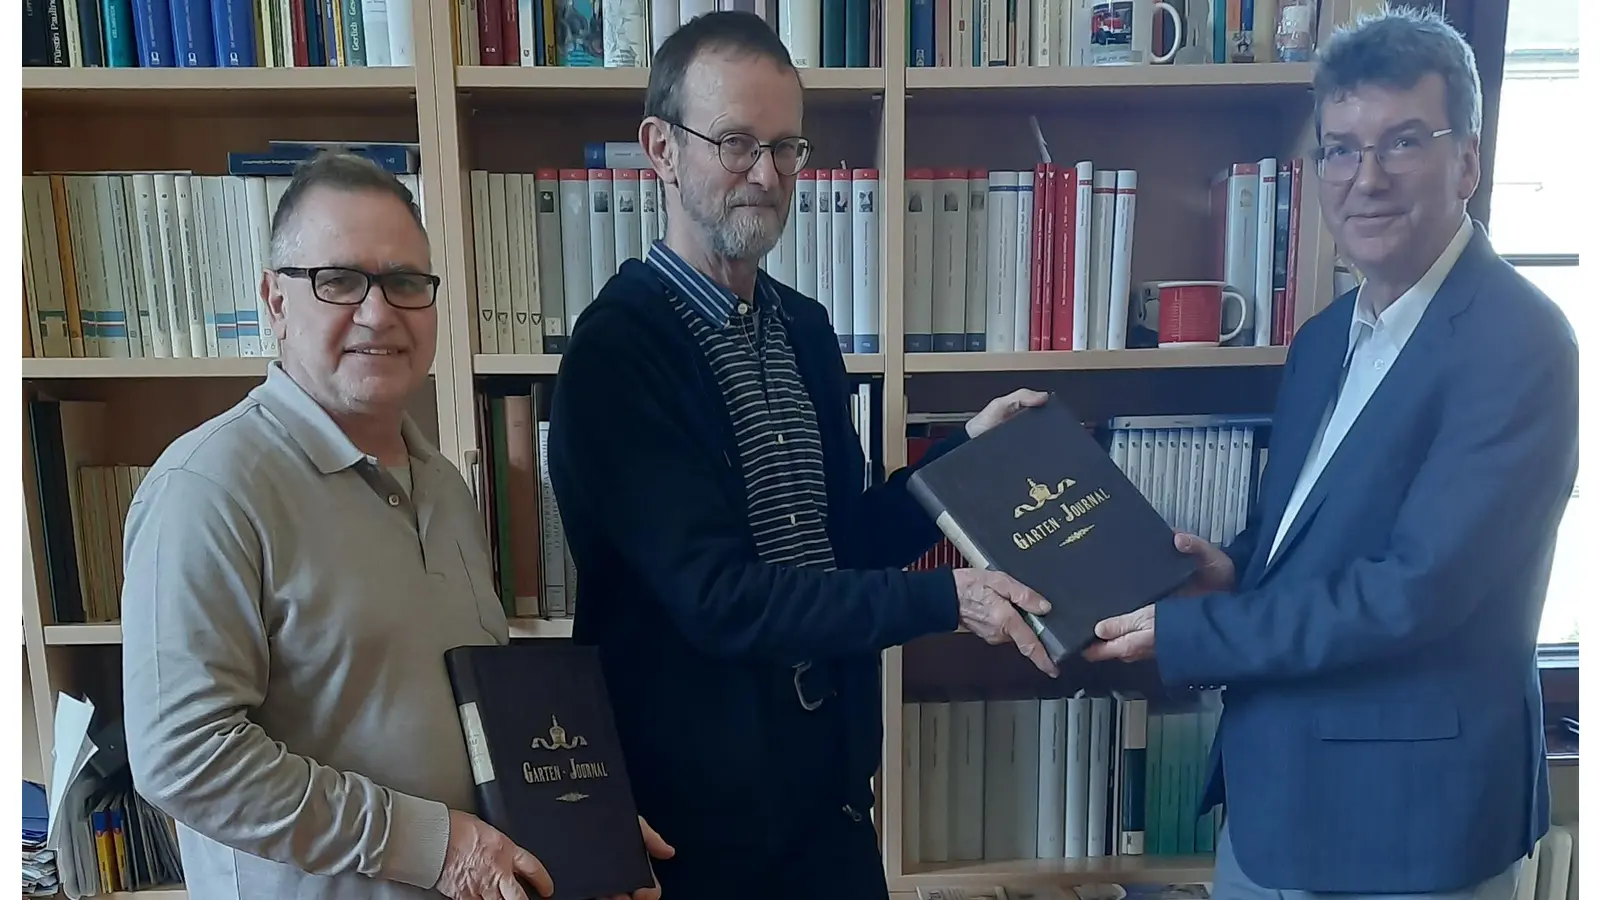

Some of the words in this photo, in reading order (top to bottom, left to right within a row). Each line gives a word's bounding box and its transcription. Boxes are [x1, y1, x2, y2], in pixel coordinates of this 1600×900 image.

[53, 32, 63, 64] Fürstin
[350, 22, 360, 51] Gerlich
[1012, 517, 1060, 550] GARTEN
[1060, 487, 1110, 522] JOURNAL
[522, 761, 562, 783] GARTEN
[569, 758, 608, 779] JOURNAL
